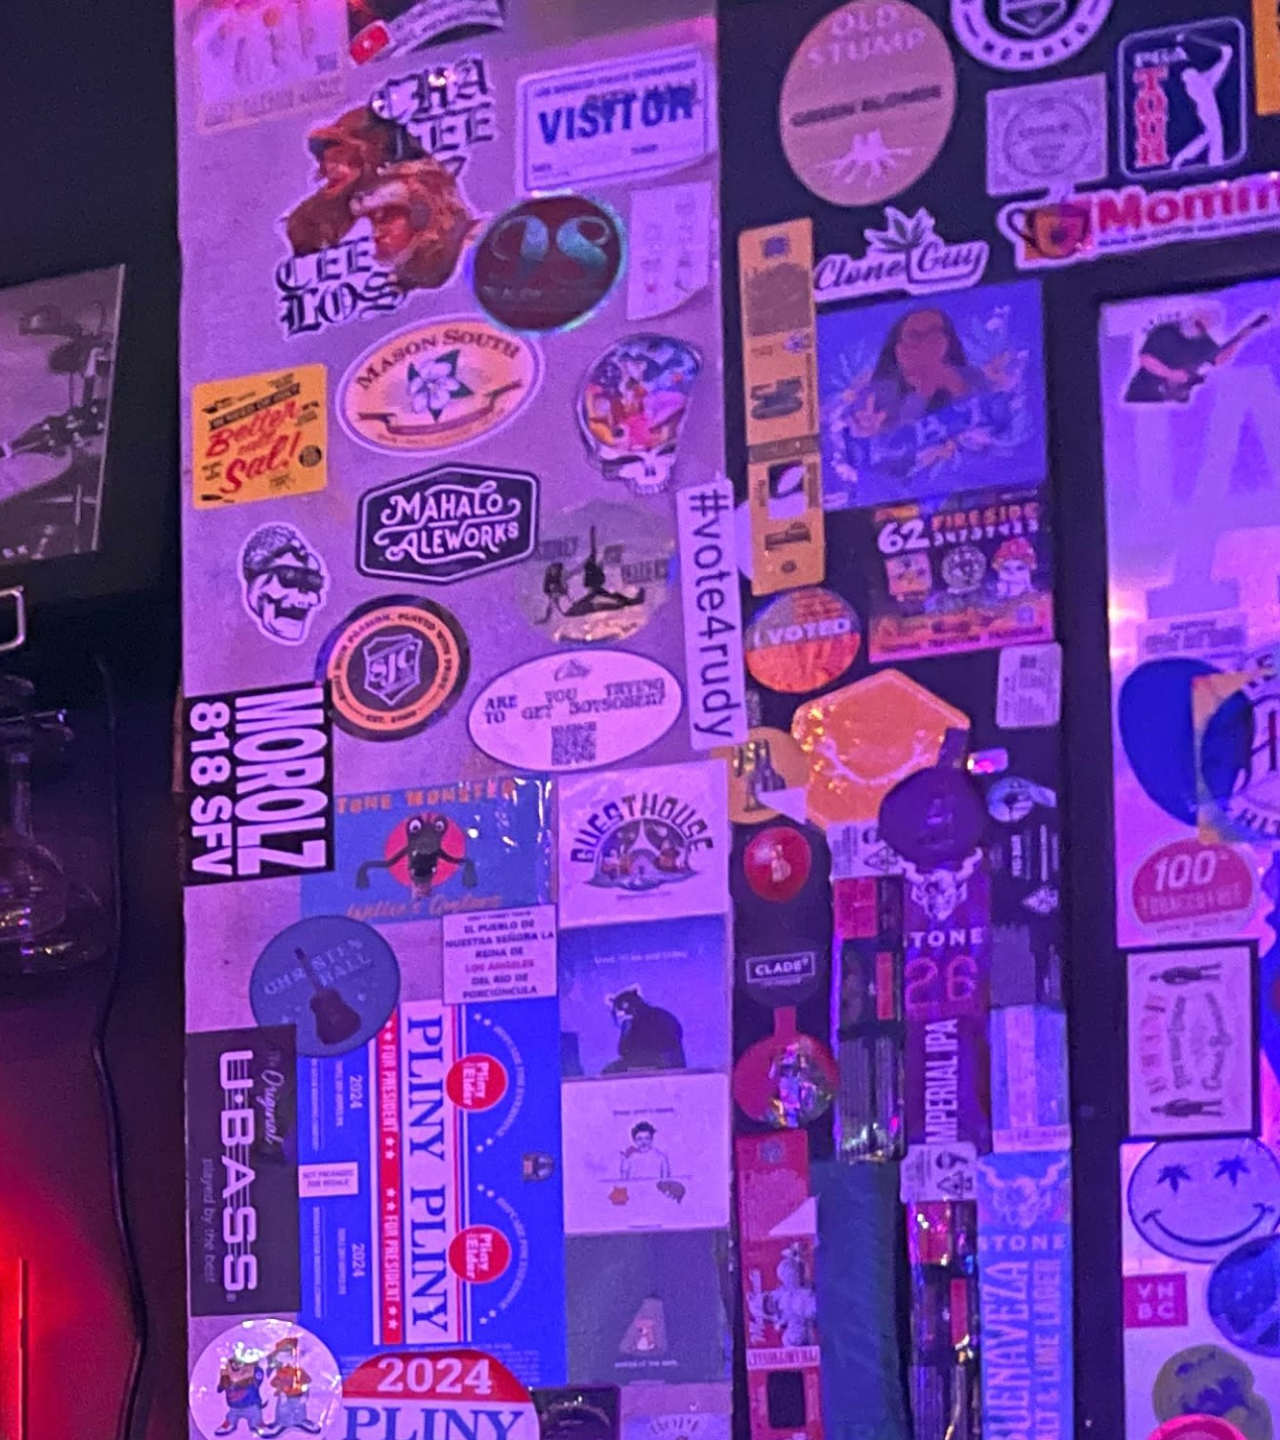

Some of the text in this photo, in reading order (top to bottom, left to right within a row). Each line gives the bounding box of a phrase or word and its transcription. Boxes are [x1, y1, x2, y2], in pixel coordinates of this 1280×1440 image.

[831, 4, 898, 35] OLD
[537, 82, 697, 146] VISITOR
[1133, 64, 1169, 168] TOUR
[814, 259, 904, 289] Clone
[281, 271, 407, 336] LOS
[357, 328, 521, 392] MASON SOUTH
[380, 482, 521, 526] MAHALO
[931, 502, 1040, 531] FIRESIDE
[373, 520, 521, 564] ALEWORKS
[877, 518, 931, 554] 62
[690, 488, 737, 739] #vote4rudy
[485, 695, 518, 710] ARE
[544, 687, 578, 704] YOU
[190, 702, 234, 877] 818 SFV
[235, 687, 328, 875] MOROLZ
[571, 792, 714, 865] GUESTHOUSE
[1152, 852, 1217, 892] 100
[904, 955, 979, 1012] 26
[349, 1074, 364, 1109] 2024
[382, 1044, 398, 1133] FOR PRESIDENT
[474, 1061, 490, 1100] Pliny
[407, 1015, 448, 1332] PLINY PLINY
[351, 1243, 366, 1278] 2024
[384, 1215, 400, 1303] FOR PRESIDENT
[477, 1233, 493, 1271] Pliny
[1032, 1260, 1061, 1326] LAGER
[378, 1357, 493, 1395] 2024
[1034, 1334, 1061, 1383] LIME
